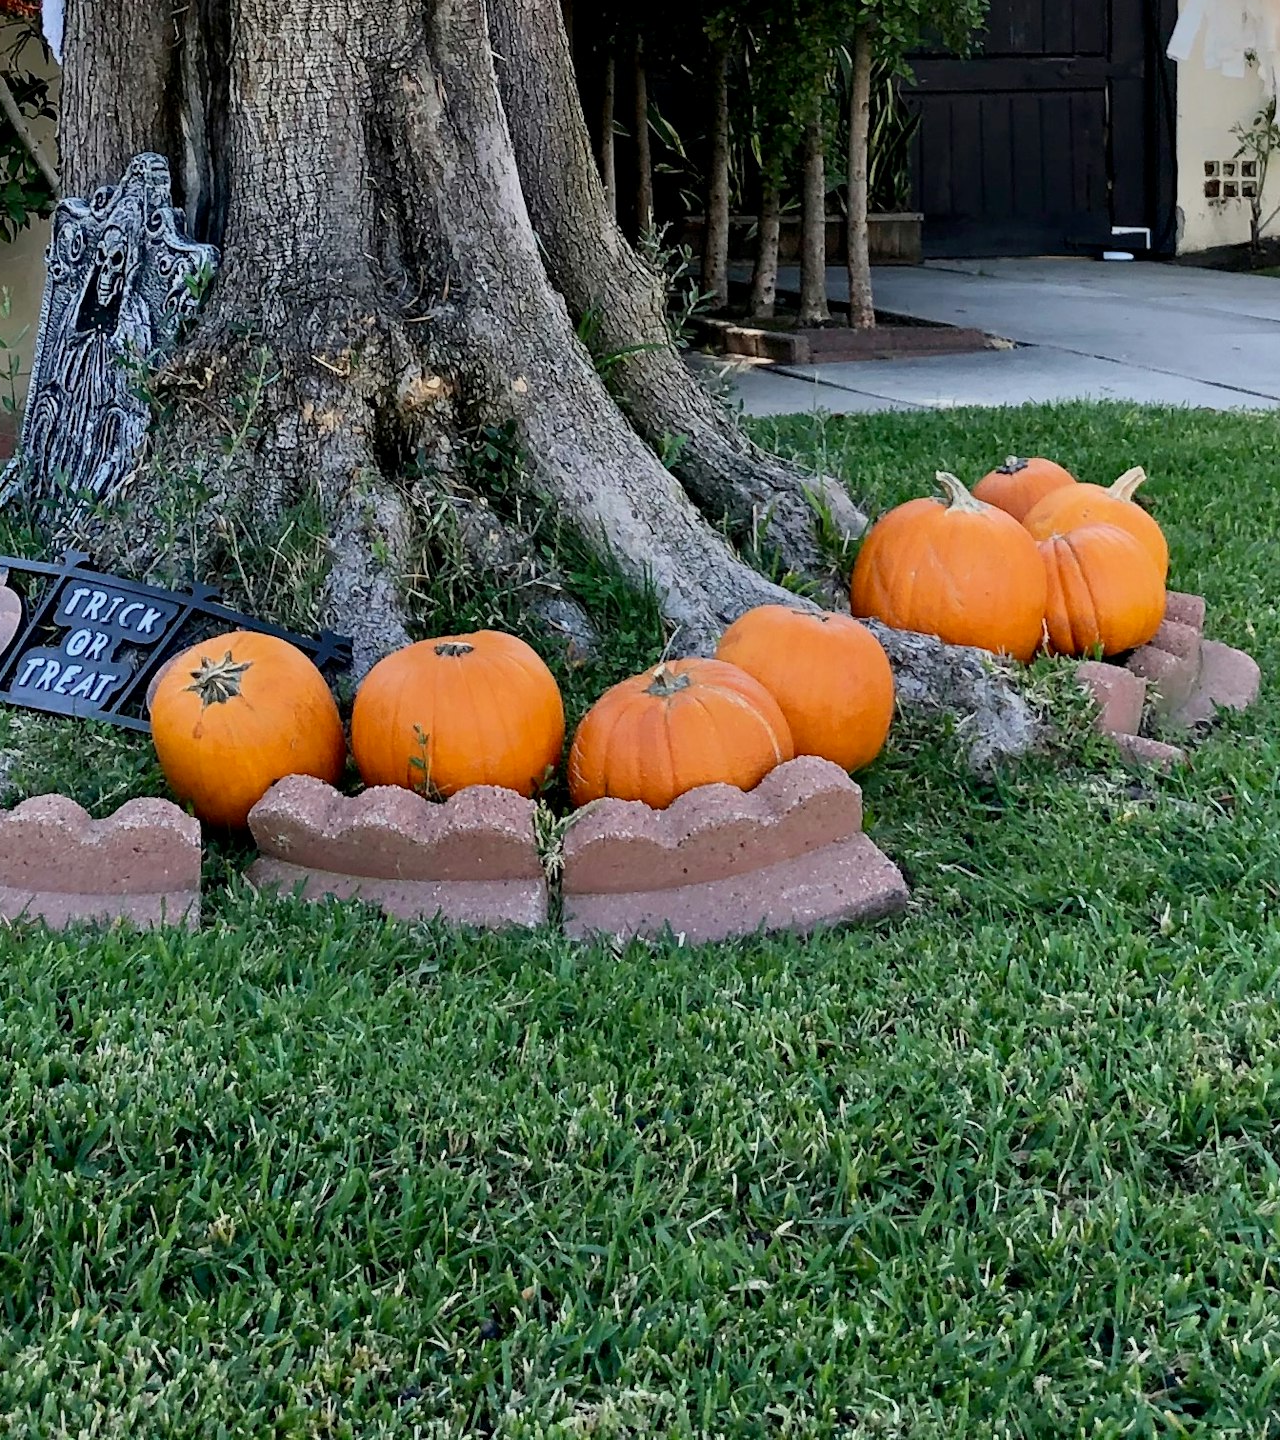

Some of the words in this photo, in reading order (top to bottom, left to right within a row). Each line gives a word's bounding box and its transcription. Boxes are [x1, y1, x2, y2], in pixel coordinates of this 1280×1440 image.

[64, 587, 162, 634] TRICK
[65, 627, 109, 660] OR
[18, 657, 117, 701] TREAT
